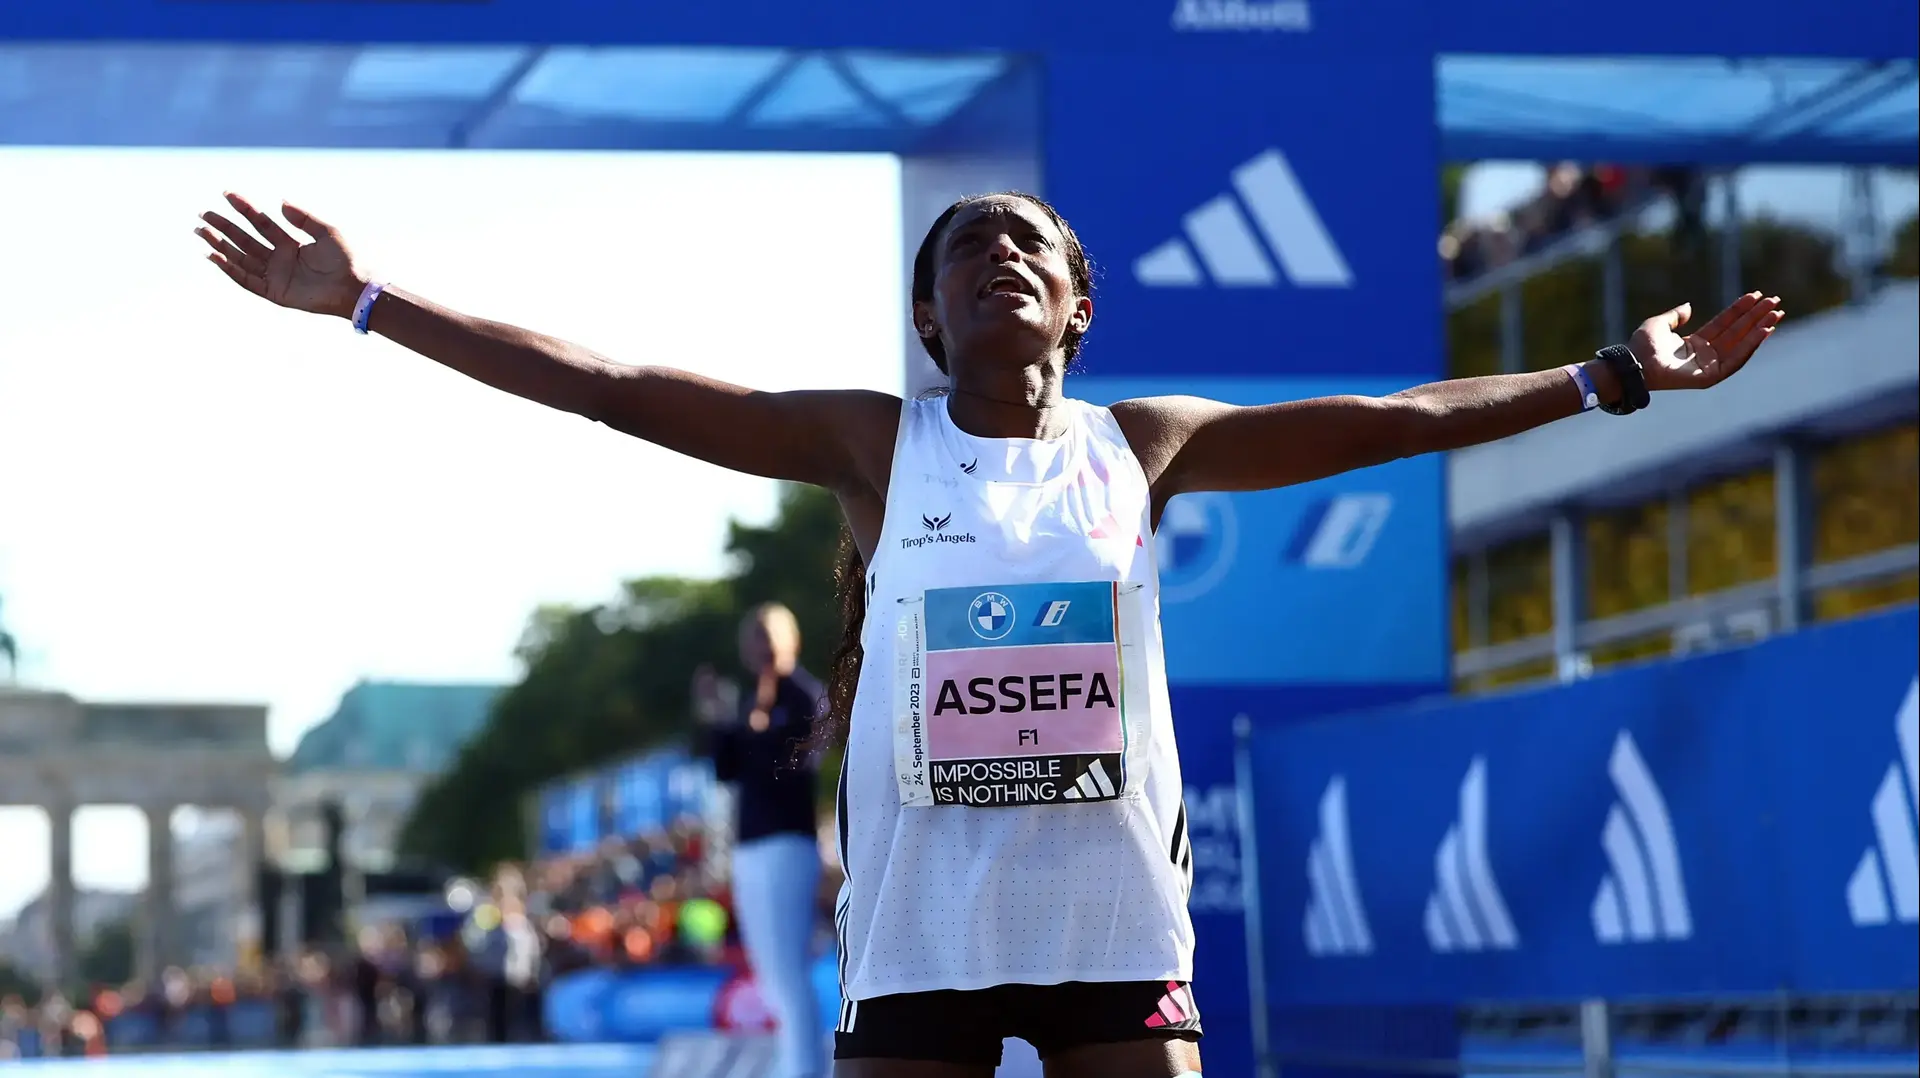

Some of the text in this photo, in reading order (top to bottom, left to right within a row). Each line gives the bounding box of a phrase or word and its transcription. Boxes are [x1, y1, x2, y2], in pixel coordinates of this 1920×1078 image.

[901, 532, 976, 549] Tirop's Angels
[933, 672, 1115, 716] ASSEFA
[909, 683, 924, 786] 24. September 2023
[1018, 728, 1039, 746] F1
[933, 759, 1061, 784] IMPOSSIBLE
[935, 782, 1057, 804] IS NOTHING
